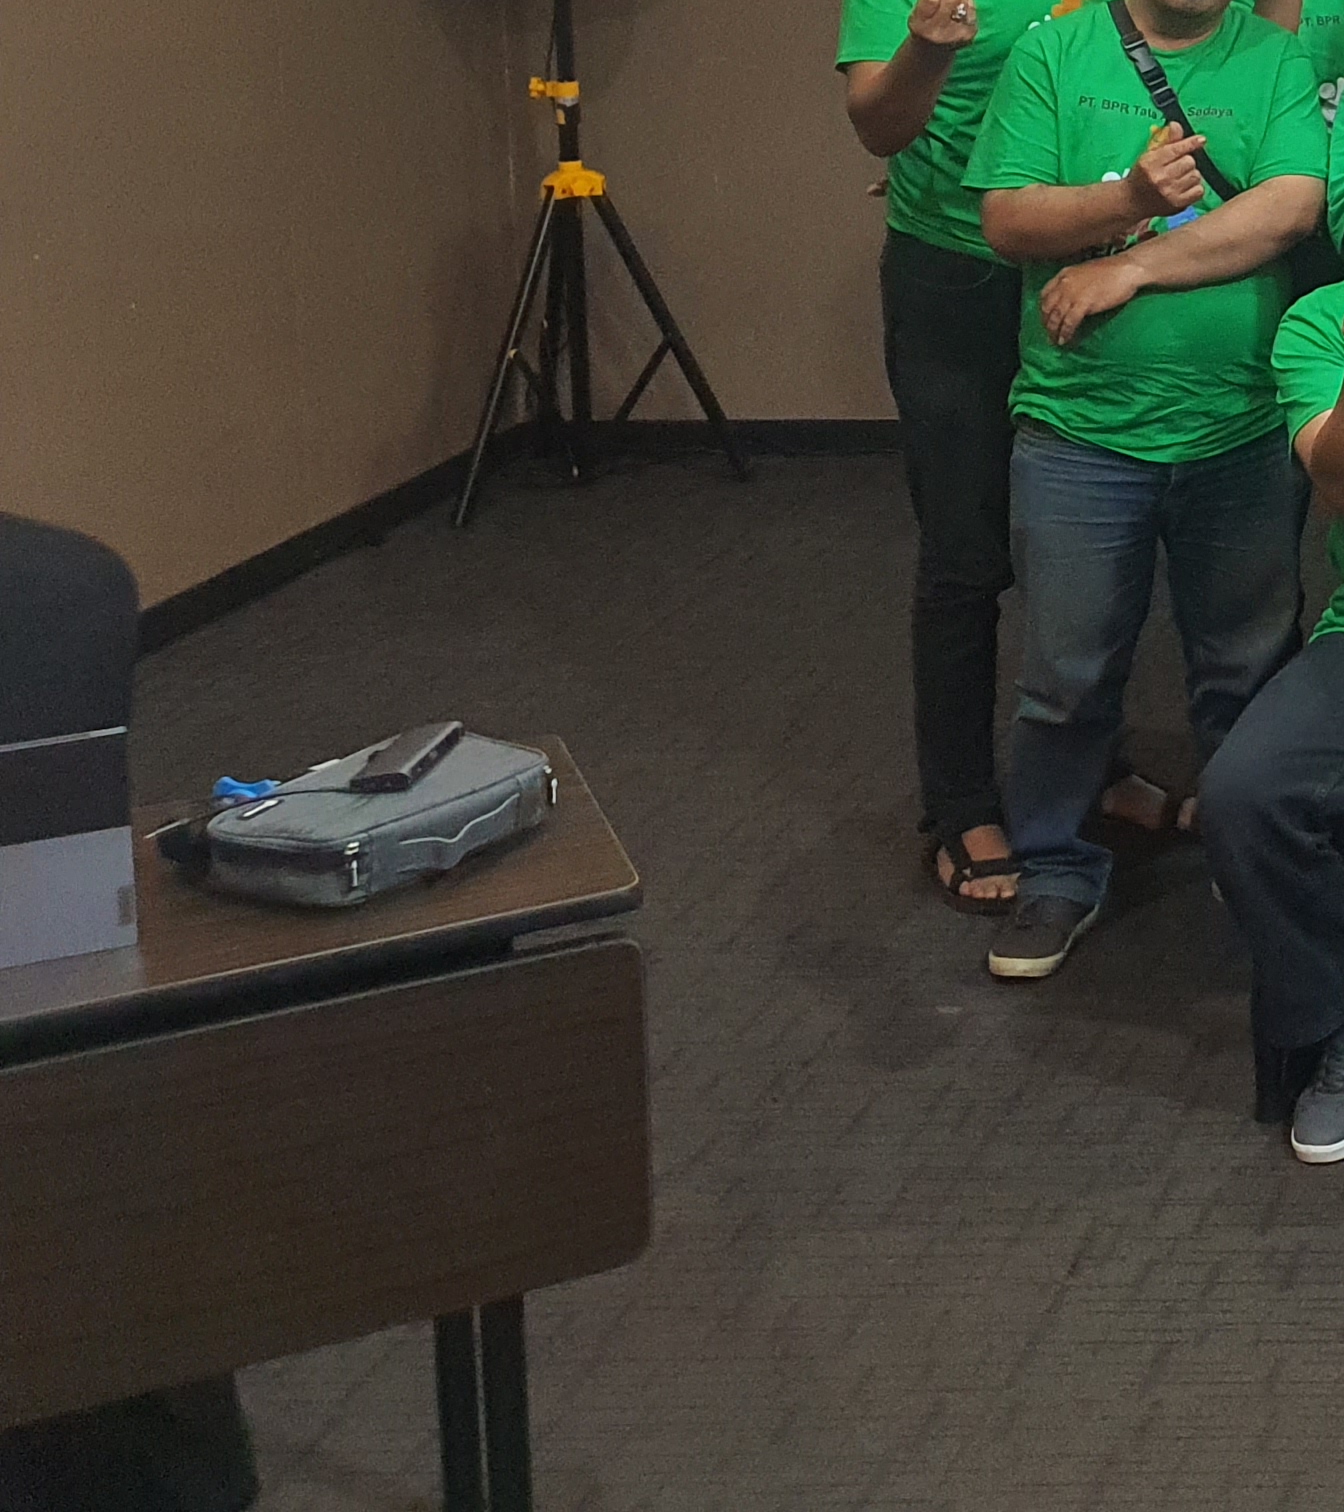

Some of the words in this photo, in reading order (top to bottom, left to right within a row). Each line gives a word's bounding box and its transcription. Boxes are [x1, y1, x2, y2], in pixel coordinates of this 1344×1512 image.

[1317, 15, 1340, 26] BPR
[1078, 96, 1096, 108] PT.
[1102, 100, 1129, 114] BPR
[1134, 106, 1157, 120] Tata
[1187, 106, 1233, 118] Sadaya
